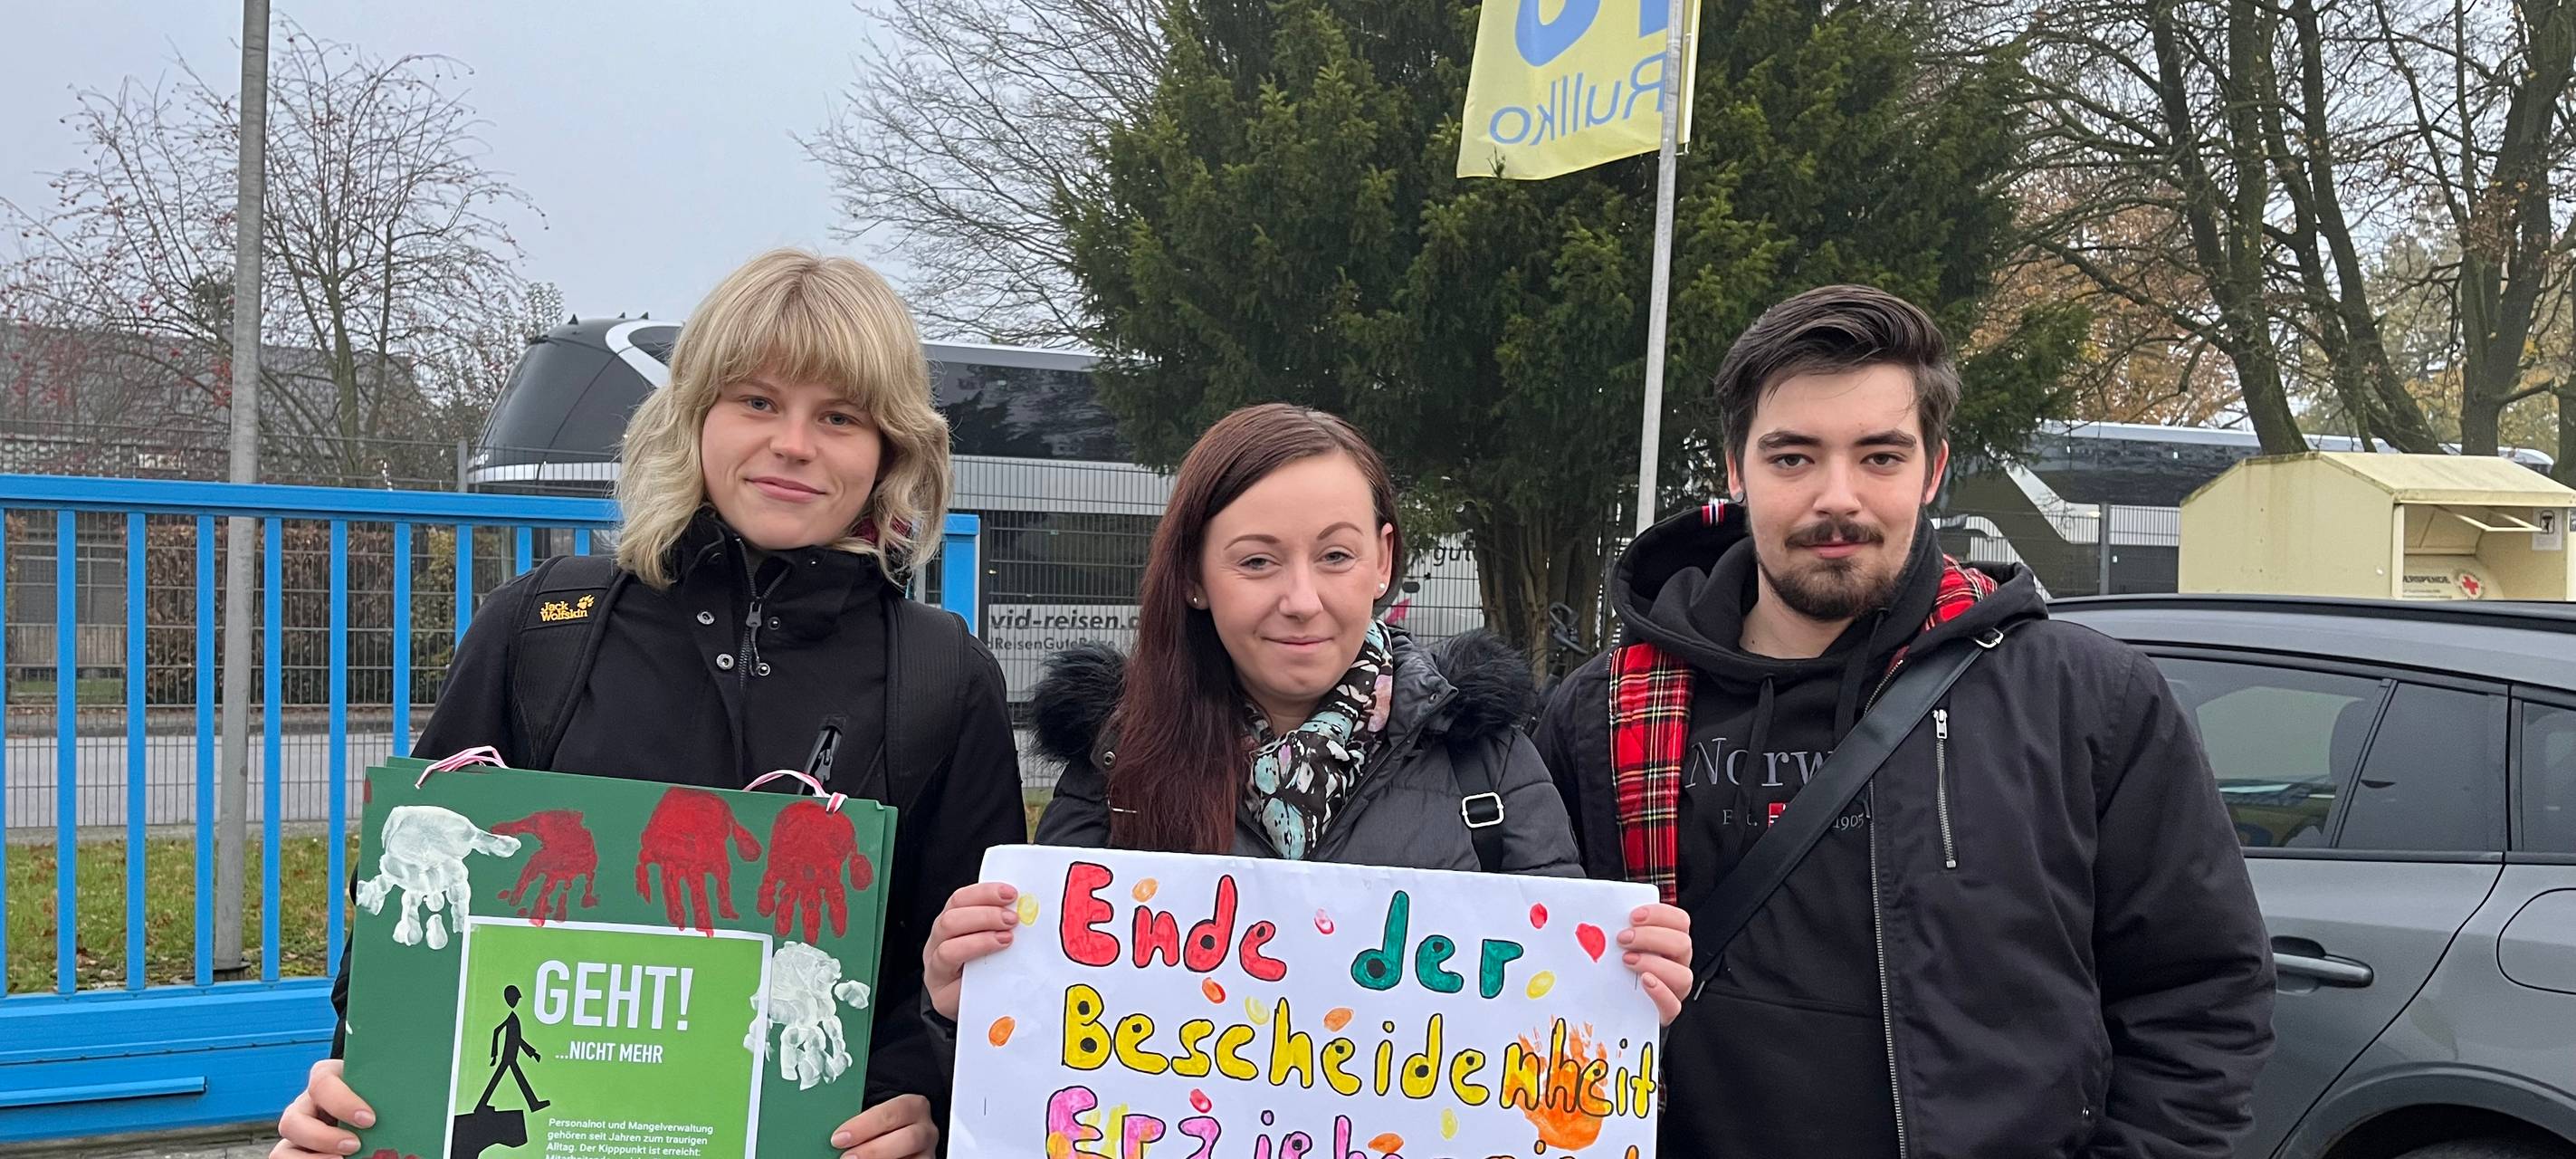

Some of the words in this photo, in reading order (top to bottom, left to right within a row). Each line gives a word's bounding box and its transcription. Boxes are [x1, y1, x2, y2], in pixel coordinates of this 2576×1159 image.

[540, 608, 587, 622] Wolfskin
[541, 601, 568, 612] Jack
[1059, 861, 1287, 982] Ende
[1350, 890, 1524, 1000] der
[534, 960, 693, 1030] GEHT!
[555, 1041, 615, 1061] ...NICHT
[619, 1044, 663, 1063] MEHR
[1061, 983, 1656, 1119] Bescheidenheit
[549, 1118, 606, 1128] Personalnot
[607, 1121, 625, 1129] und
[628, 1122, 714, 1135] Mangelverwaltung
[547, 1130, 587, 1141] gehören
[588, 1132, 606, 1140] seit
[608, 1133, 642, 1142] Jahren
[665, 1135, 708, 1146] traurigen
[546, 1142, 577, 1153] Alltag.
[579, 1144, 596, 1152] Der
[598, 1144, 646, 1154] Kipppunkt
[648, 1146, 660, 1154] ist
[663, 1147, 701, 1156] erreicht:
